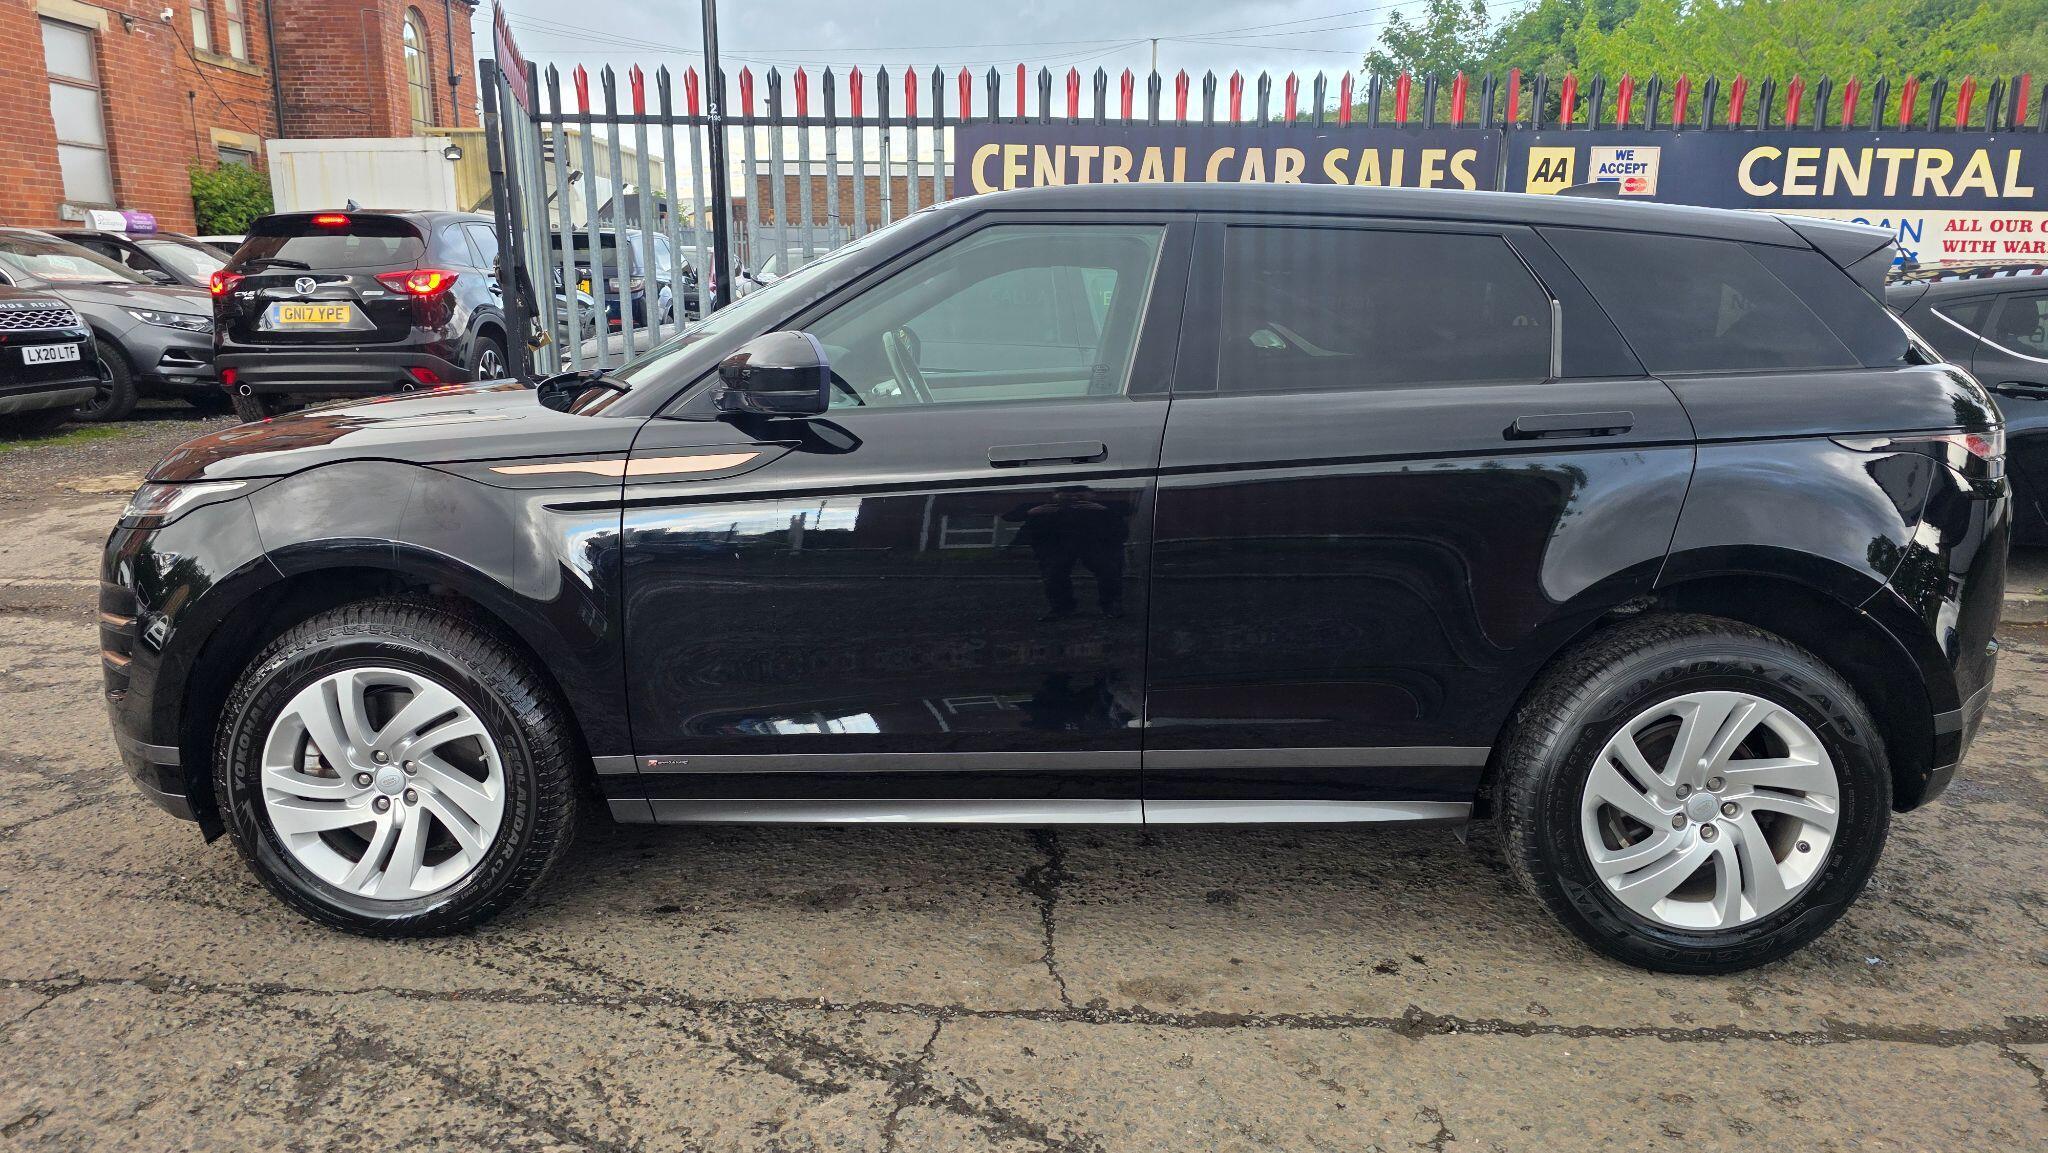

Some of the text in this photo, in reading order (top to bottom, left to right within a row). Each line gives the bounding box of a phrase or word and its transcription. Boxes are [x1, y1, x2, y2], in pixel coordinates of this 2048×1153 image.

[1615, 150, 1635, 161] WE
[971, 143, 1478, 191] CENTRAL CAR SALES
[1531, 157, 1568, 183] AA
[1598, 162, 1648, 175] ACCEPT
[1737, 146, 2035, 198] CENTRAL
[1944, 219, 1982, 233] ALL
[1989, 219, 2034, 233] OUR
[1942, 240, 2048, 254] WITH WAR
[284, 308, 344, 321] GN17 YPE
[28, 346, 76, 362] LX20 LTF
[235, 681, 282, 791] YOKOHAMA
[501, 734, 527, 860] GEOLANDAR
